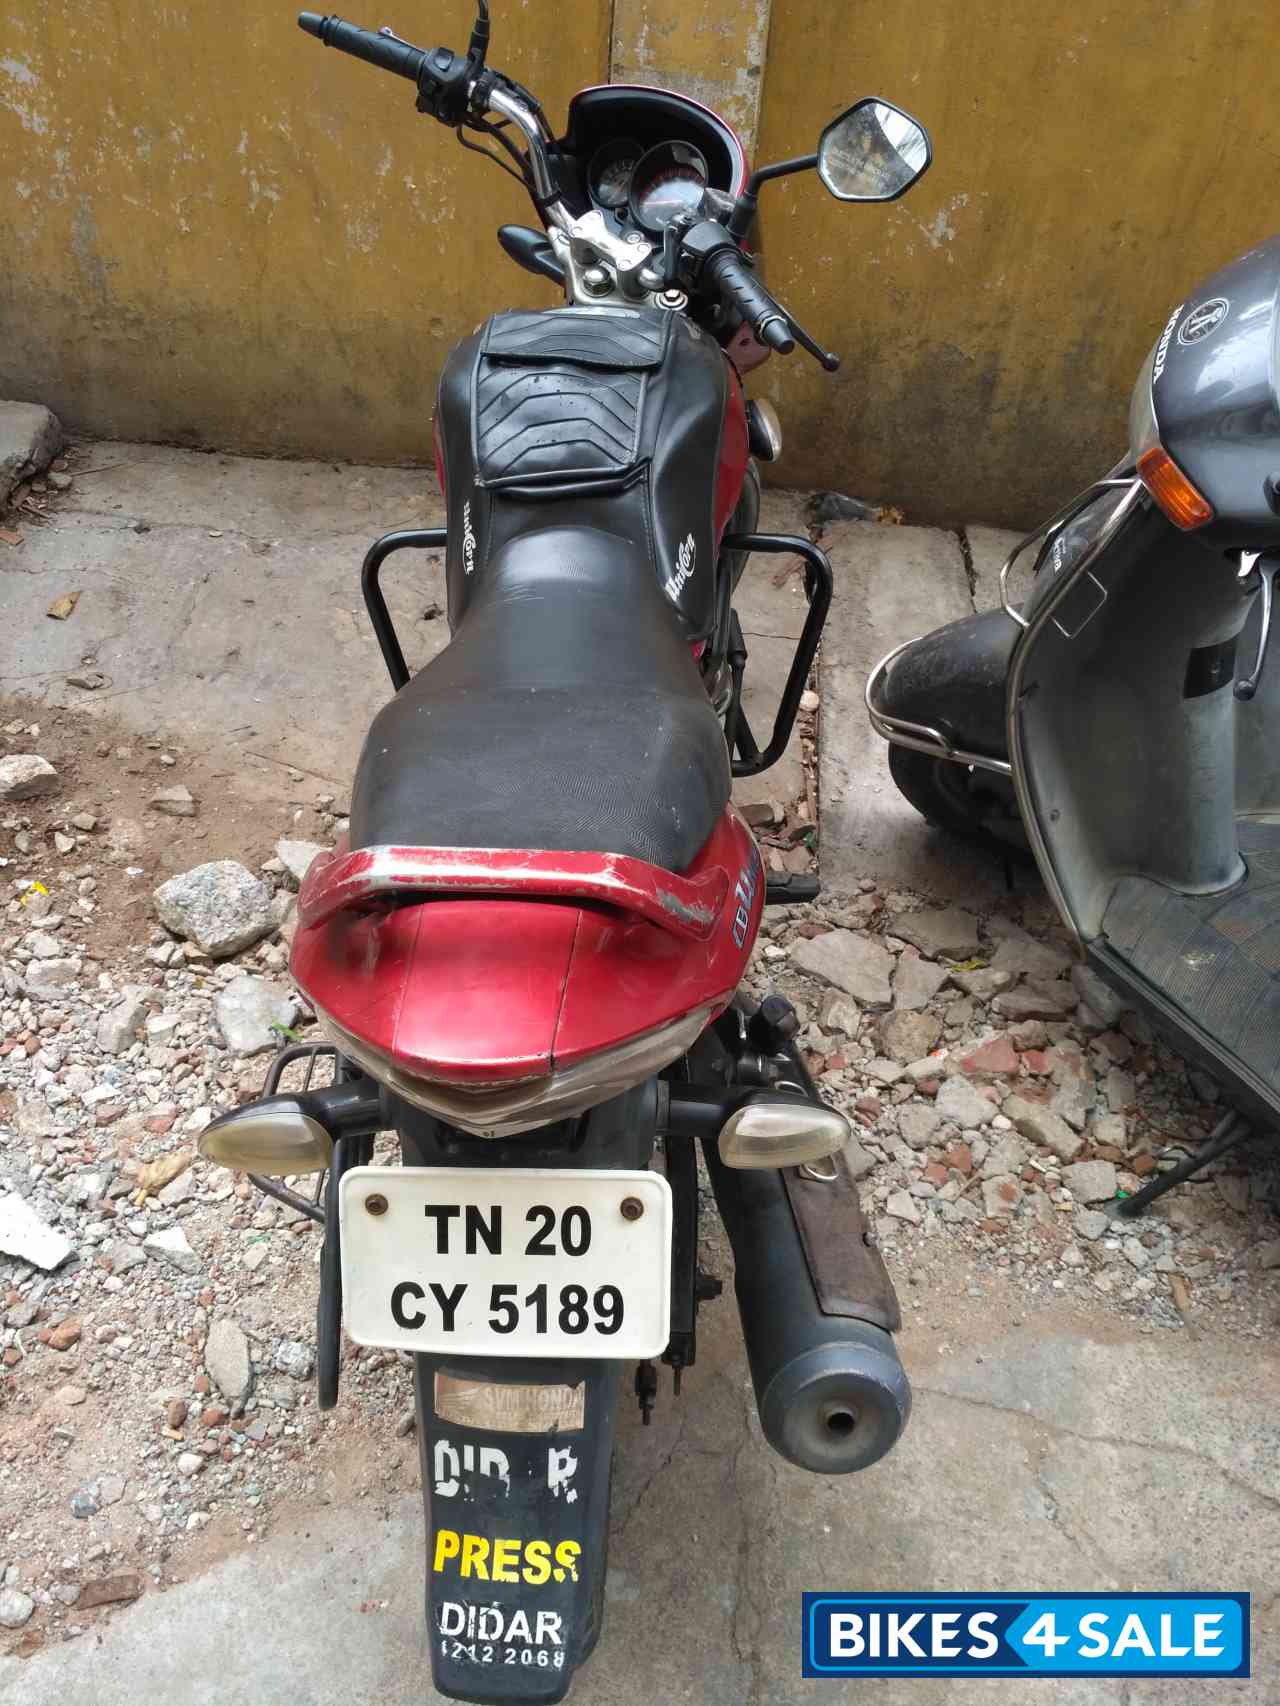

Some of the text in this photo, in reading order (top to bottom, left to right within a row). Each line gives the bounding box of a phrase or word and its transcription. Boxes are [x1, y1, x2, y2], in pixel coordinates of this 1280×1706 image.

[1153, 304, 1184, 384] HONDA
[424, 1205, 592, 1257] TN 20
[390, 1281, 625, 1335] CY 5189
[433, 1529, 581, 1585] PRESS
[440, 1601, 562, 1645] DIDAR
